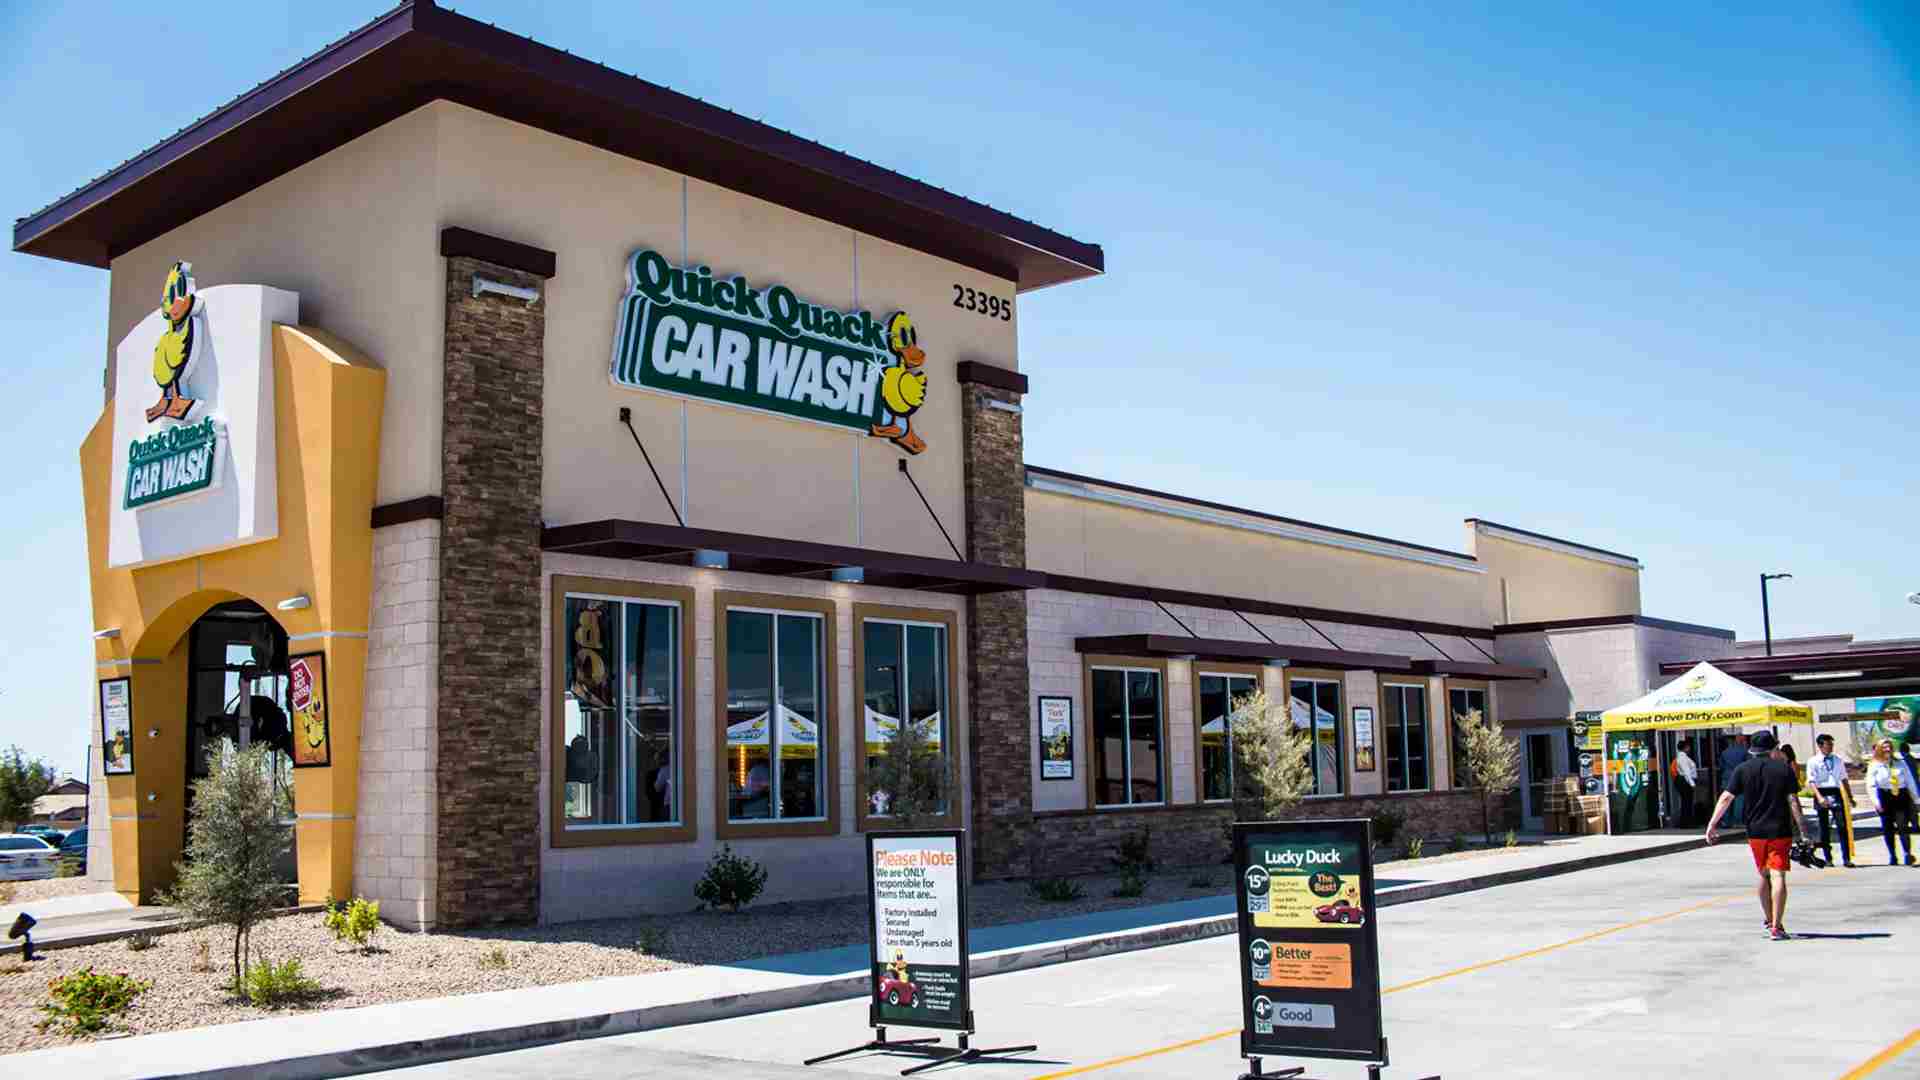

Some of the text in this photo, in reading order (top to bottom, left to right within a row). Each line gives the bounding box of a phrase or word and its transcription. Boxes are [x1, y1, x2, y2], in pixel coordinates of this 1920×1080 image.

[635, 250, 887, 349] Quick Quack
[952, 284, 1012, 321] 23395
[651, 314, 880, 418] CAR WASH
[129, 416, 214, 463] Quick Quack
[130, 446, 209, 500] CAR WASH
[1625, 711, 1743, 725] Dont Drive Dirty.com
[875, 850, 954, 866] Please Note
[1265, 848, 1341, 867] Lucky Duck
[903, 867, 926, 877] ONLY
[876, 878, 936, 889] responsible for
[899, 889, 915, 899] that
[885, 907, 908, 918] Factory
[886, 918, 910, 926] Secured
[886, 928, 925, 939] Undamaged
[886, 938, 953, 949] Less than 5 years old
[1276, 945, 1312, 960] Better
[1280, 1007, 1313, 1022] Good
